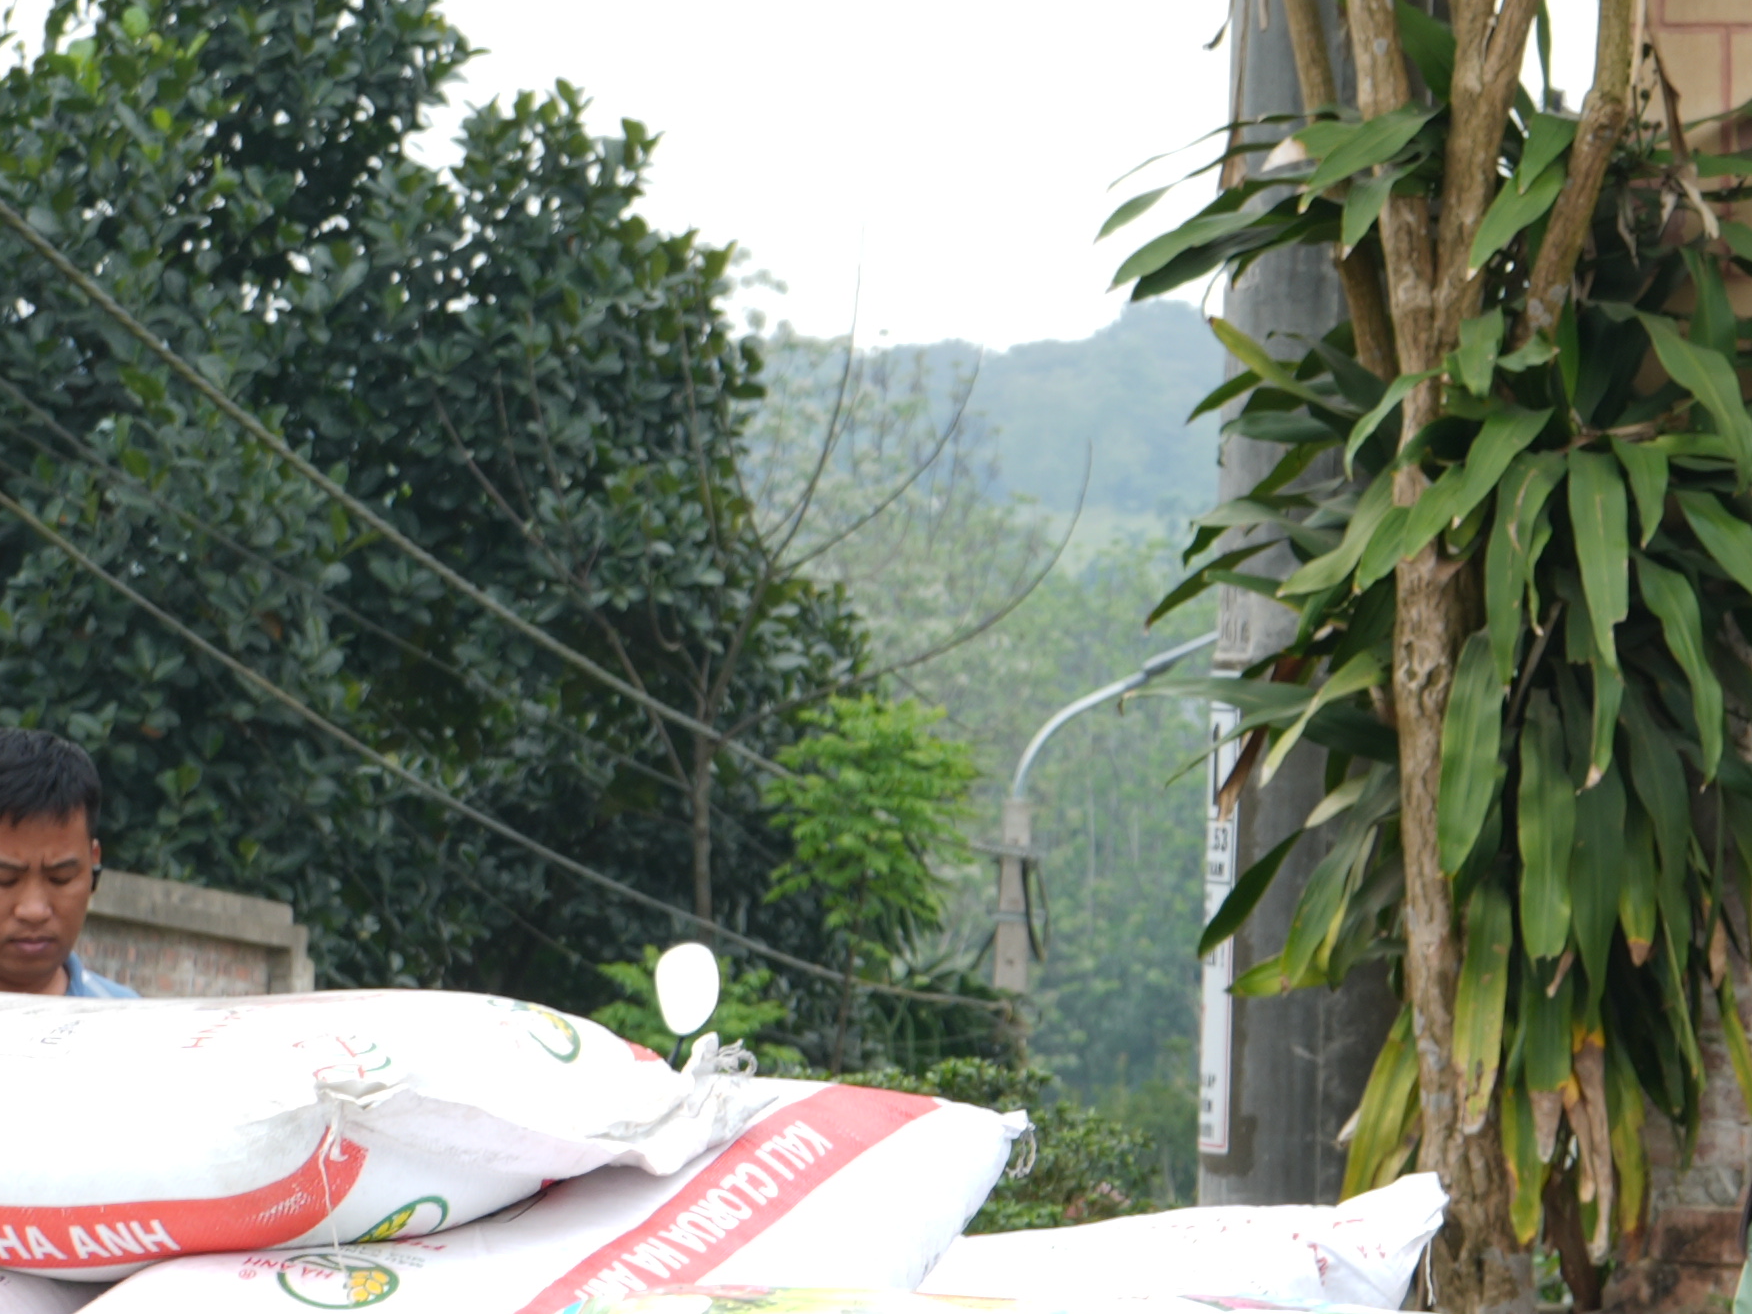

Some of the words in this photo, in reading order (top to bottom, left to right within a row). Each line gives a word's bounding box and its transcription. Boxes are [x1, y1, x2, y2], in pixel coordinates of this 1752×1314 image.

[755, 1120, 834, 1181] KALI
[659, 1162, 780, 1254] CLORUA
[68, 1219, 181, 1260] ANH
